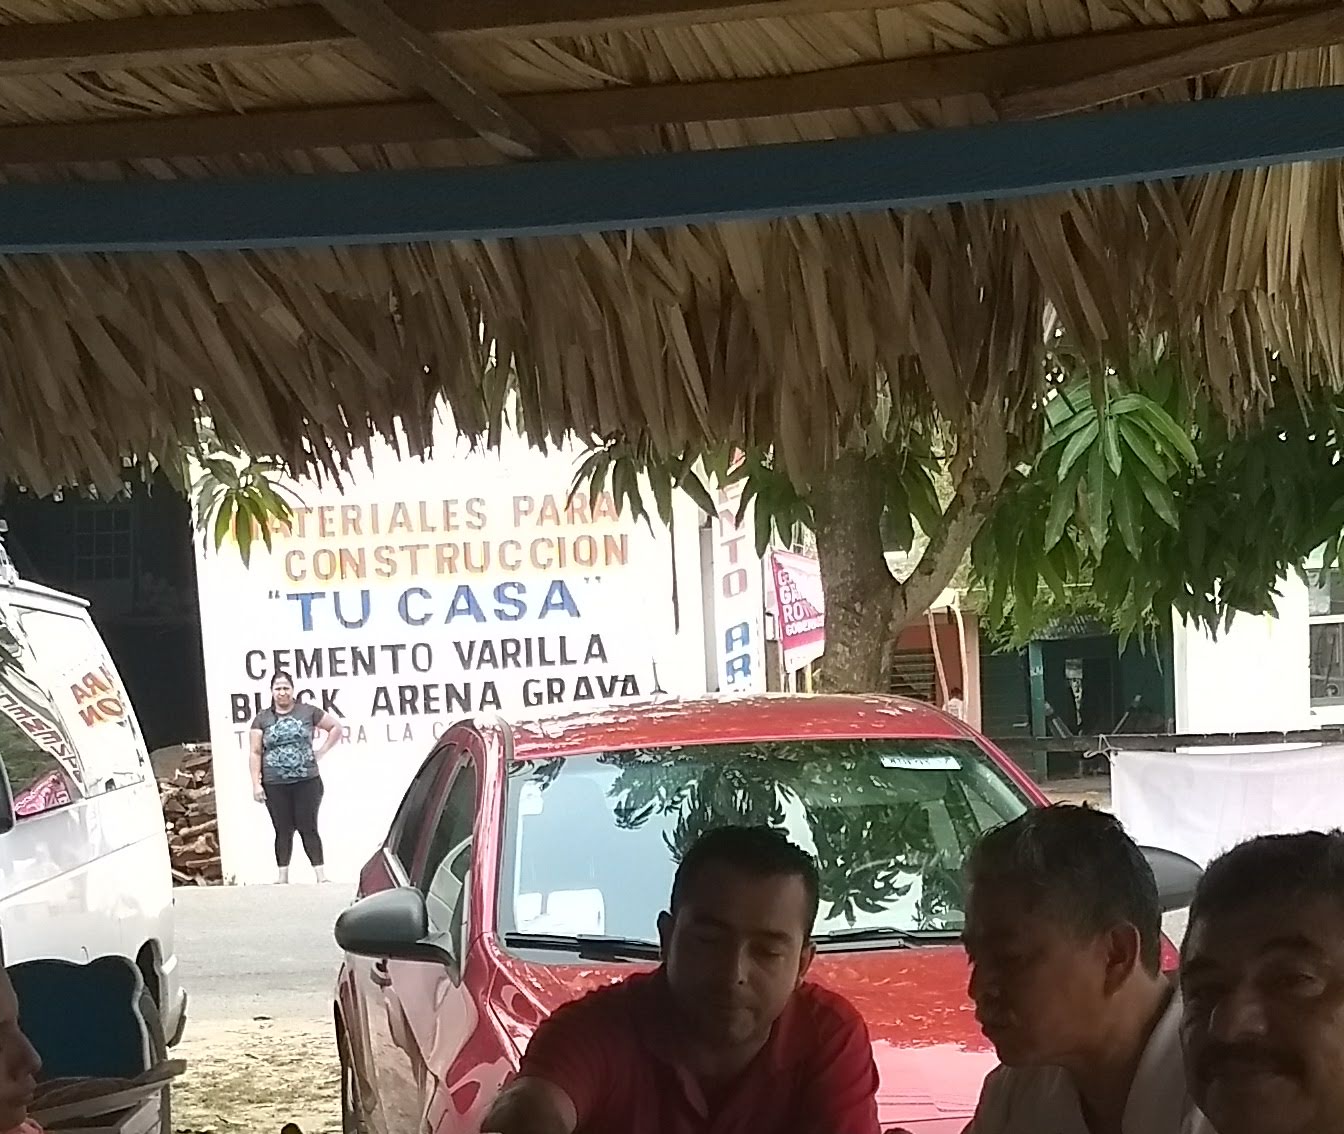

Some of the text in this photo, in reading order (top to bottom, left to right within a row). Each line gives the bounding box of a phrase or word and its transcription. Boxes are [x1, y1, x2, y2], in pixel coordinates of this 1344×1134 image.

[512, 490, 622, 531] PARA
[284, 533, 630, 582] CONSTRUCCION
[245, 633, 608, 681] CEMENTO VARILLA
[230, 674, 641, 724] BLK ARENA GRAVA
[386, 722, 414, 743] LA
